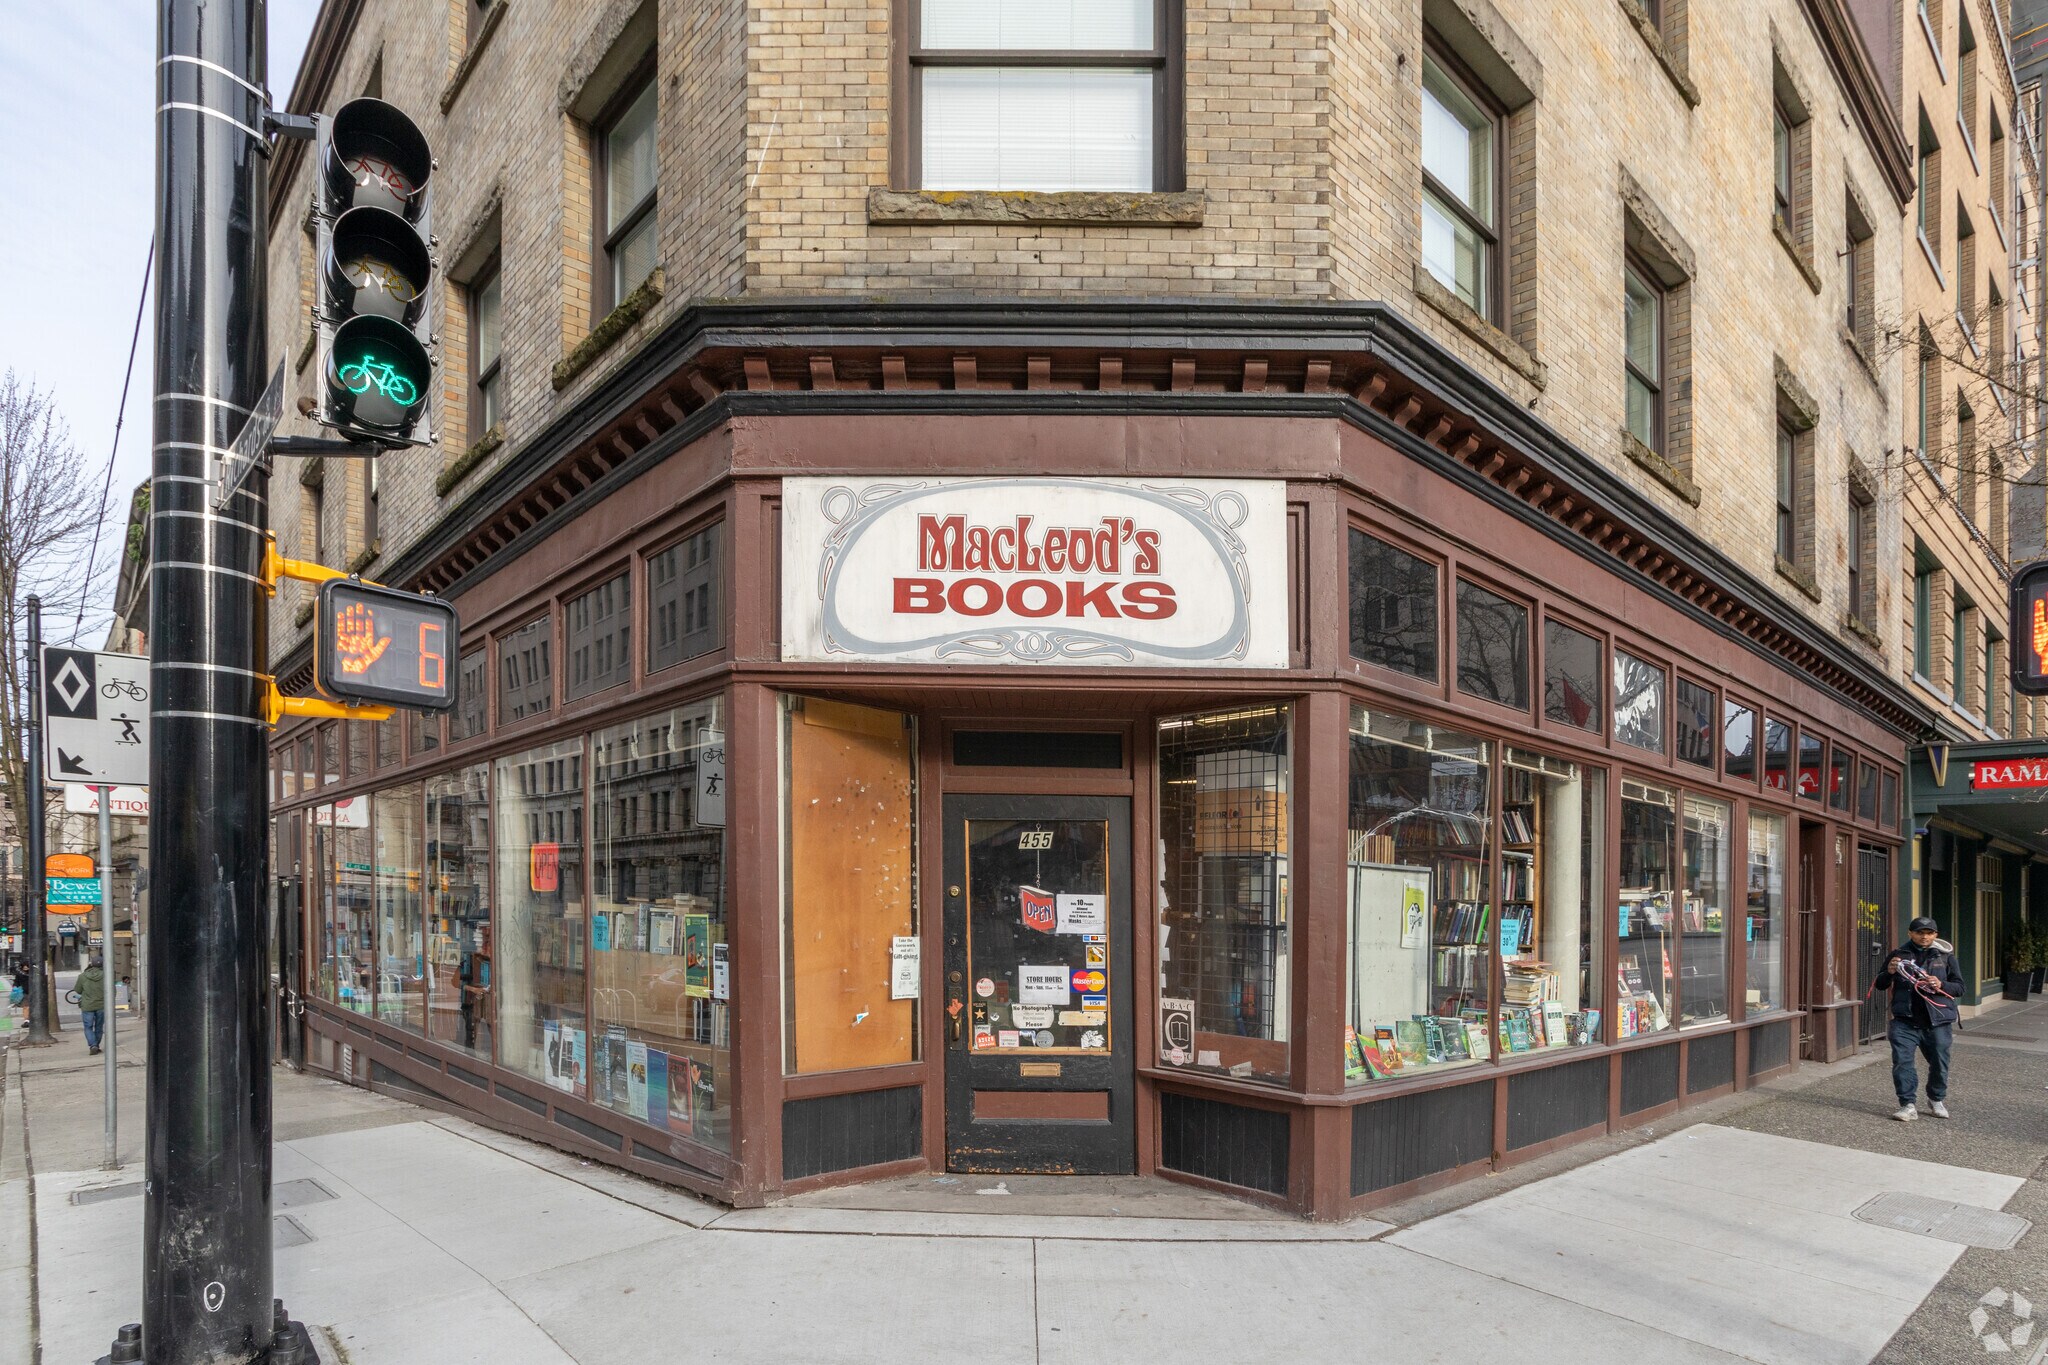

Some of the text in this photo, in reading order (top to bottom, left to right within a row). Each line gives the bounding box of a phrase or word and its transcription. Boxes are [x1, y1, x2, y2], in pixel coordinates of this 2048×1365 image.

[917, 513, 1161, 576] MacLeod's
[892, 577, 1178, 620] BOOKS
[419, 622, 445, 689] 6
[1021, 832, 1052, 848] 455
[534, 852, 558, 880] OPEN
[53, 879, 101, 891] Bewel
[1026, 900, 1053, 923] OPEN
[1072, 977, 1105, 986] MasterCard
